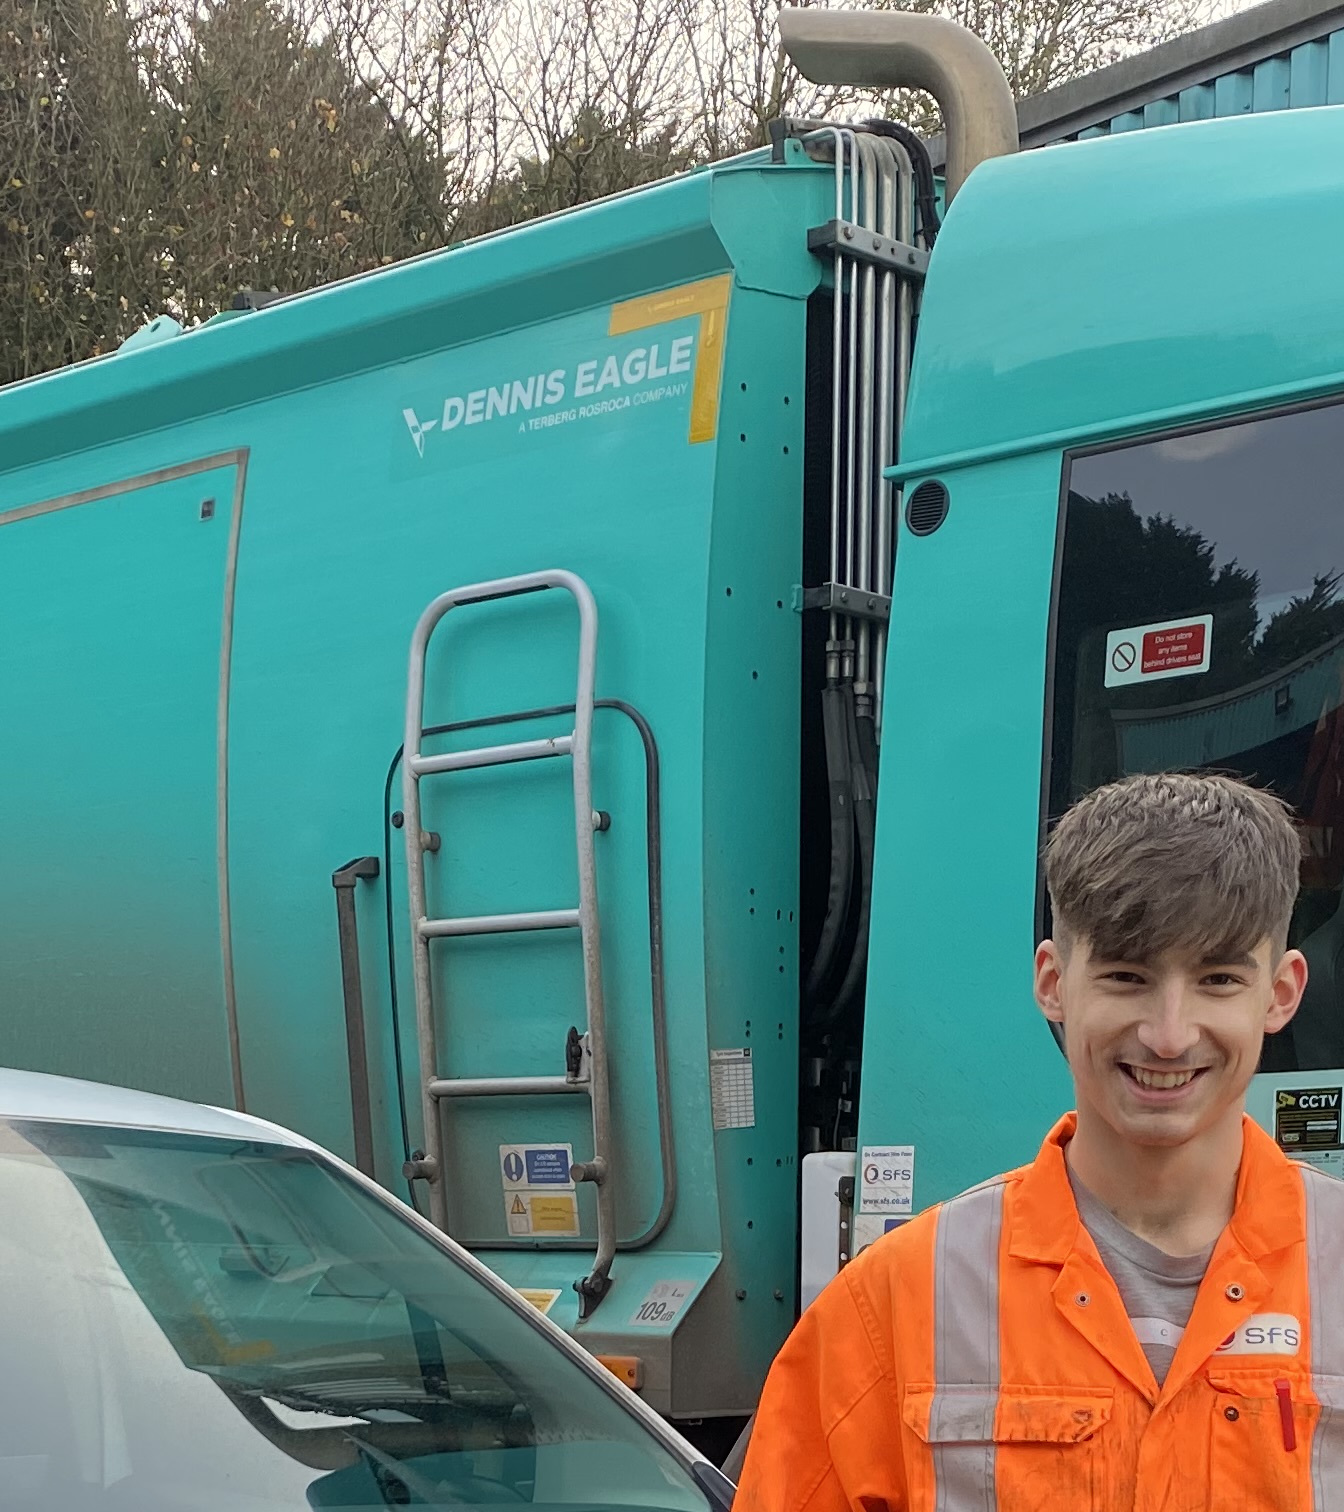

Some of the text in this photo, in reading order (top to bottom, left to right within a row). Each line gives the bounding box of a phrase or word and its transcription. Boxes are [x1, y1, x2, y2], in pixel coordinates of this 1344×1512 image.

[441, 335, 694, 432] DENNIS EAGLE
[518, 382, 689, 434] A TERBERG ROSROCA COMPANY
[1155, 632, 1193, 644] Do not store
[1144, 658, 1166, 668] behind
[1299, 1094, 1339, 1109] CCTV
[863, 1197, 910, 1205] www.sfs.co.uk
